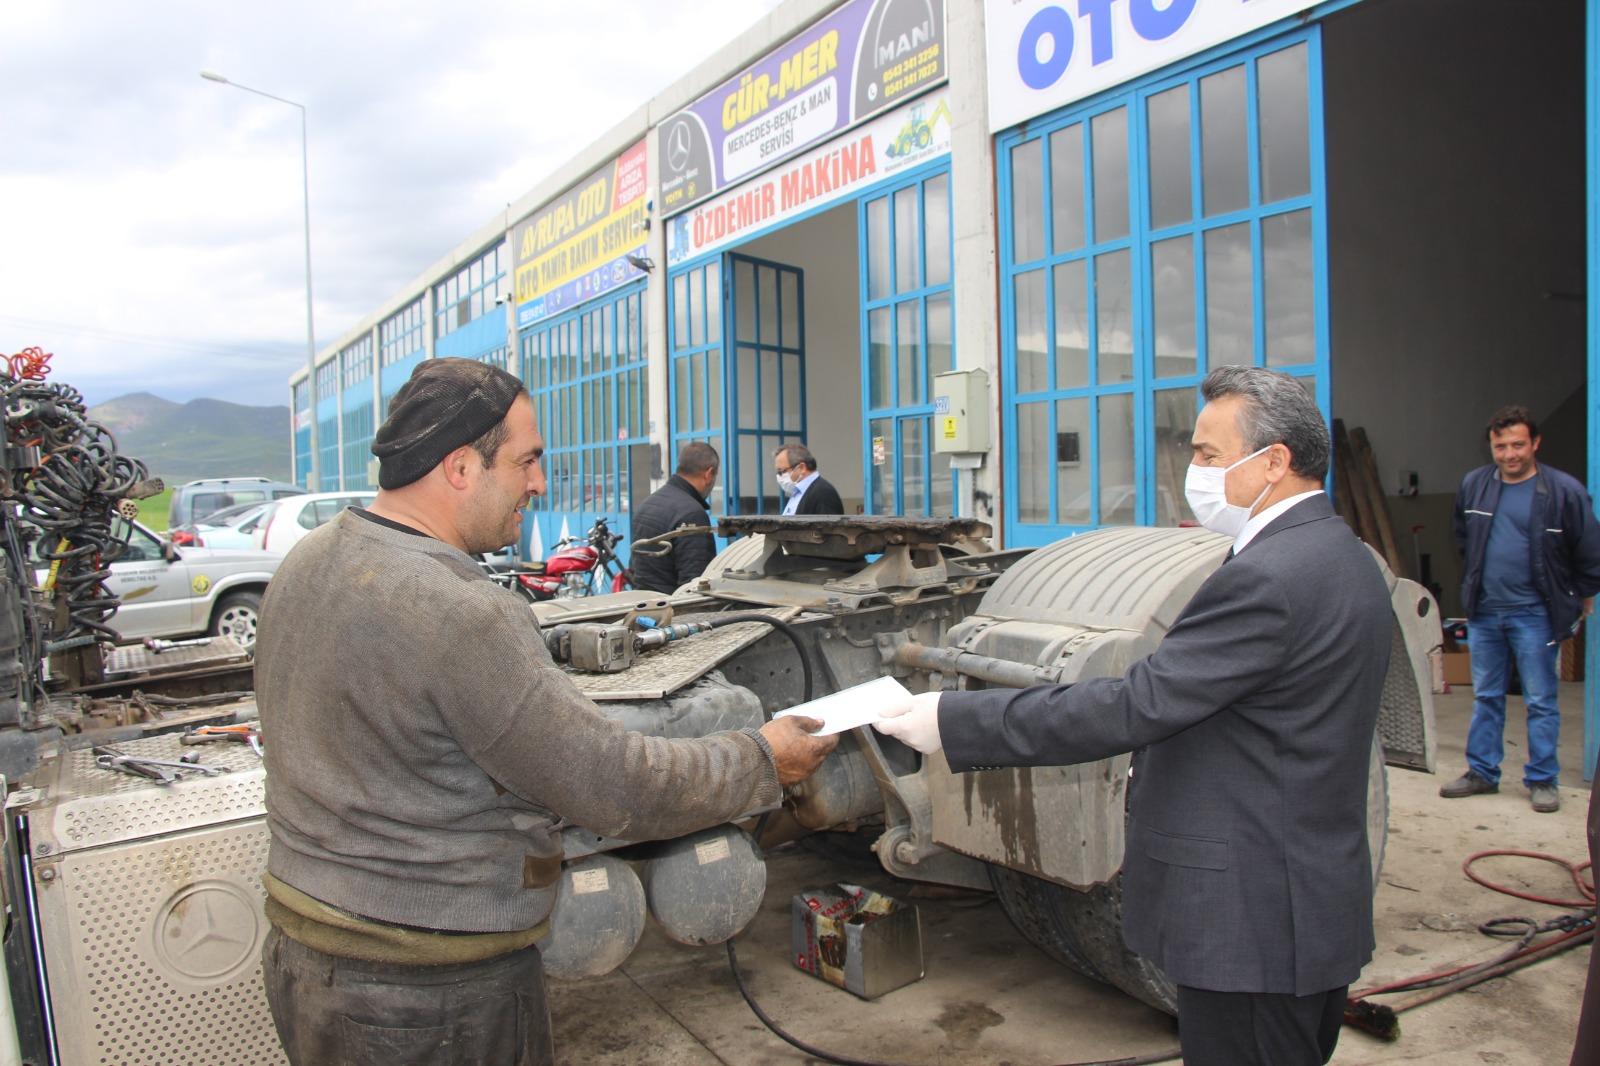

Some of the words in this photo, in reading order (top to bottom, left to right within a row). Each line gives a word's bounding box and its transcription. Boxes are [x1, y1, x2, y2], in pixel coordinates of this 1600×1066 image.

[722, 29, 839, 132] GÜR-MER
[878, 20, 929, 66] MAN
[727, 106, 798, 156] MERCEDES-BENZ
[800, 101, 809, 117] &
[808, 85, 831, 111] MAN
[759, 127, 794, 159] SERVİSİ
[520, 199, 576, 260] AVRUPA
[577, 177, 607, 226] OTO
[693, 181, 775, 249] ÖZDEMİR
[780, 135, 876, 212] MAKİNA
